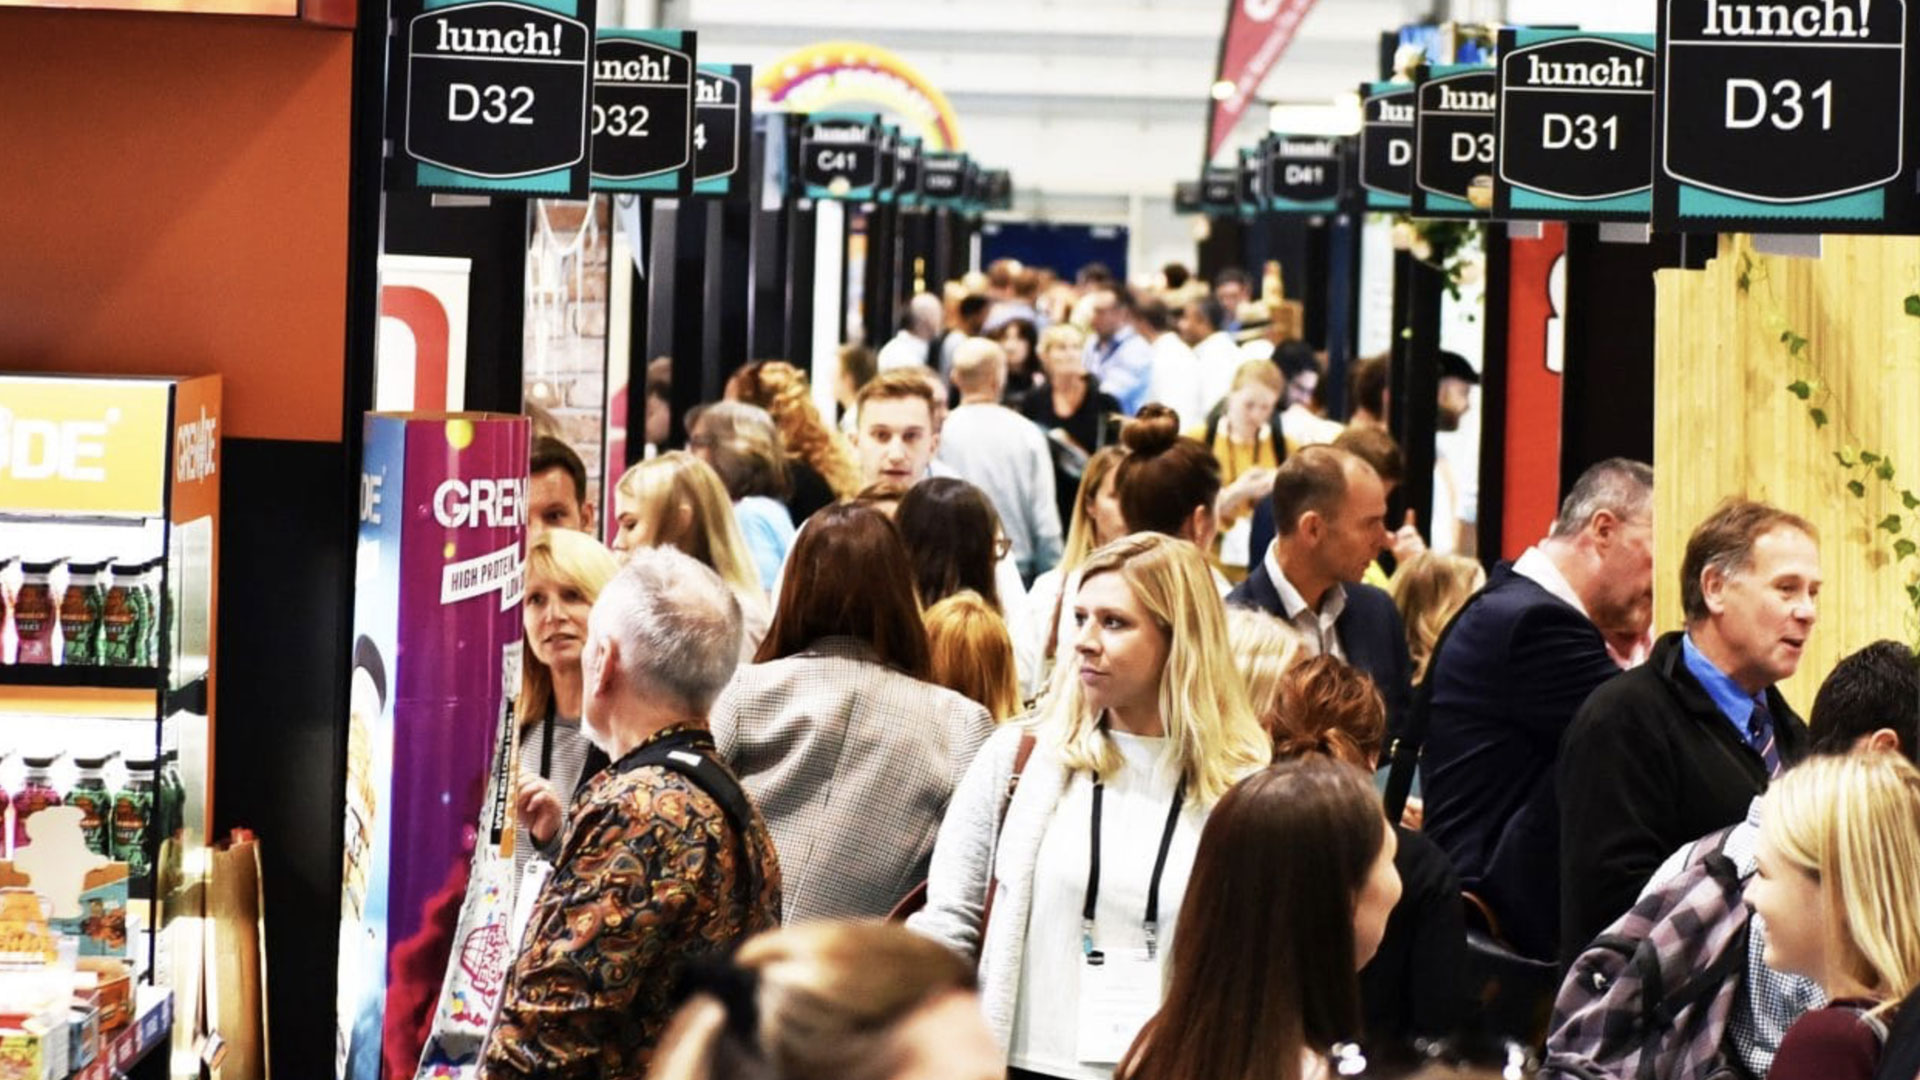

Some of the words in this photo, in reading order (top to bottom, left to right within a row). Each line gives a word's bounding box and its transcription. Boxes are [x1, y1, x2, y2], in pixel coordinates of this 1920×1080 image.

[1703, 0, 1871, 37] lunch!
[436, 19, 563, 56] lunch!
[1527, 55, 1644, 87] lunch!
[448, 83, 535, 125] D32
[1725, 79, 1834, 130] D31
[1542, 114, 1618, 151] D31
[817, 151, 857, 171] C41
[451, 567, 478, 592] HIGH
[506, 576, 519, 601] LOW
[493, 801, 505, 829] BAR
